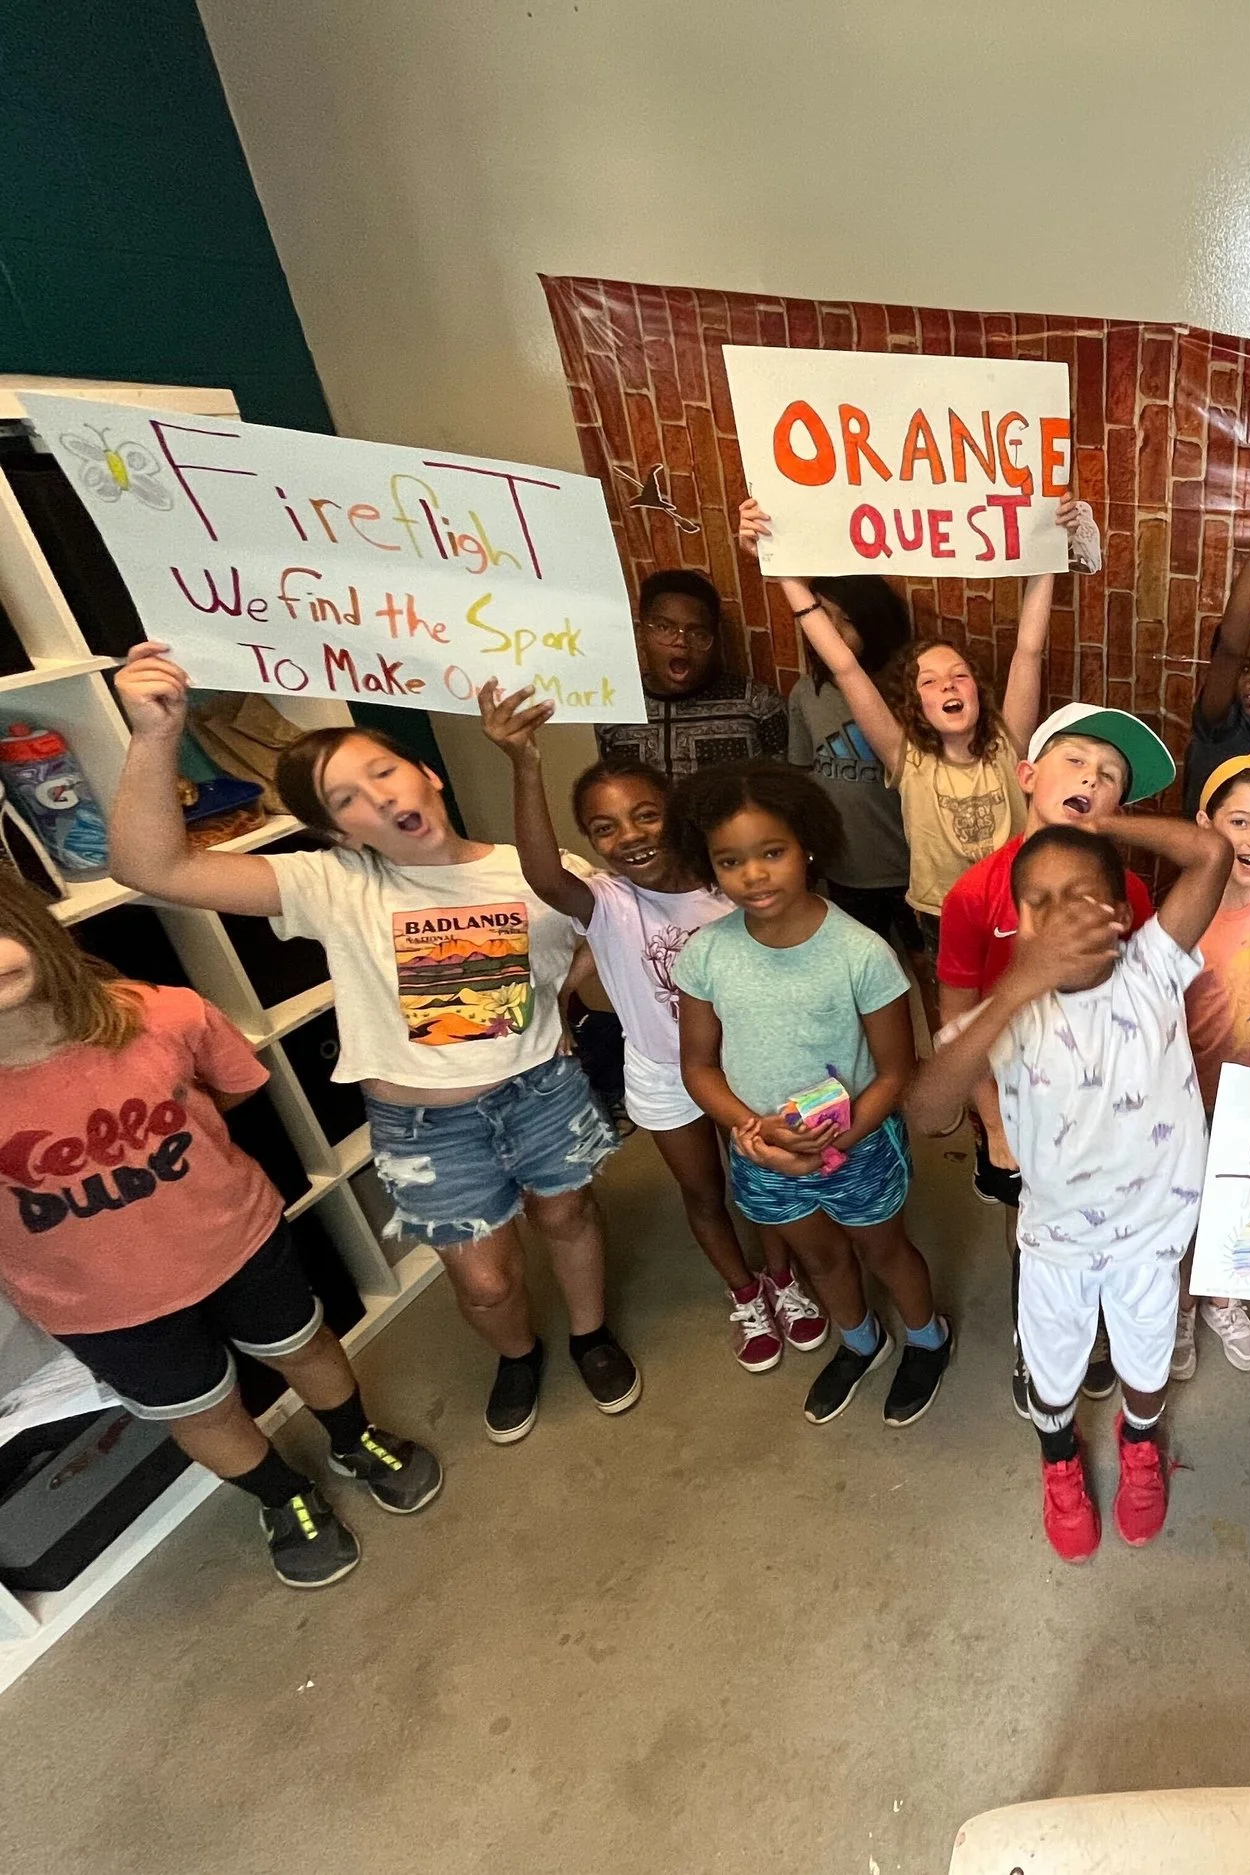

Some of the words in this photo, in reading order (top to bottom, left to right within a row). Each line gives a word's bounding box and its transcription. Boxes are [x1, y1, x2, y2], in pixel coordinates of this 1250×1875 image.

[772, 399, 1070, 497] ORANGE
[849, 494, 1032, 561] QUEST
[170, 566, 269, 623] We
[376, 592, 452, 644] the
[531, 673, 616, 707] Mark
[812, 757, 881, 783] adida
[405, 912, 523, 935] BADLANDS
